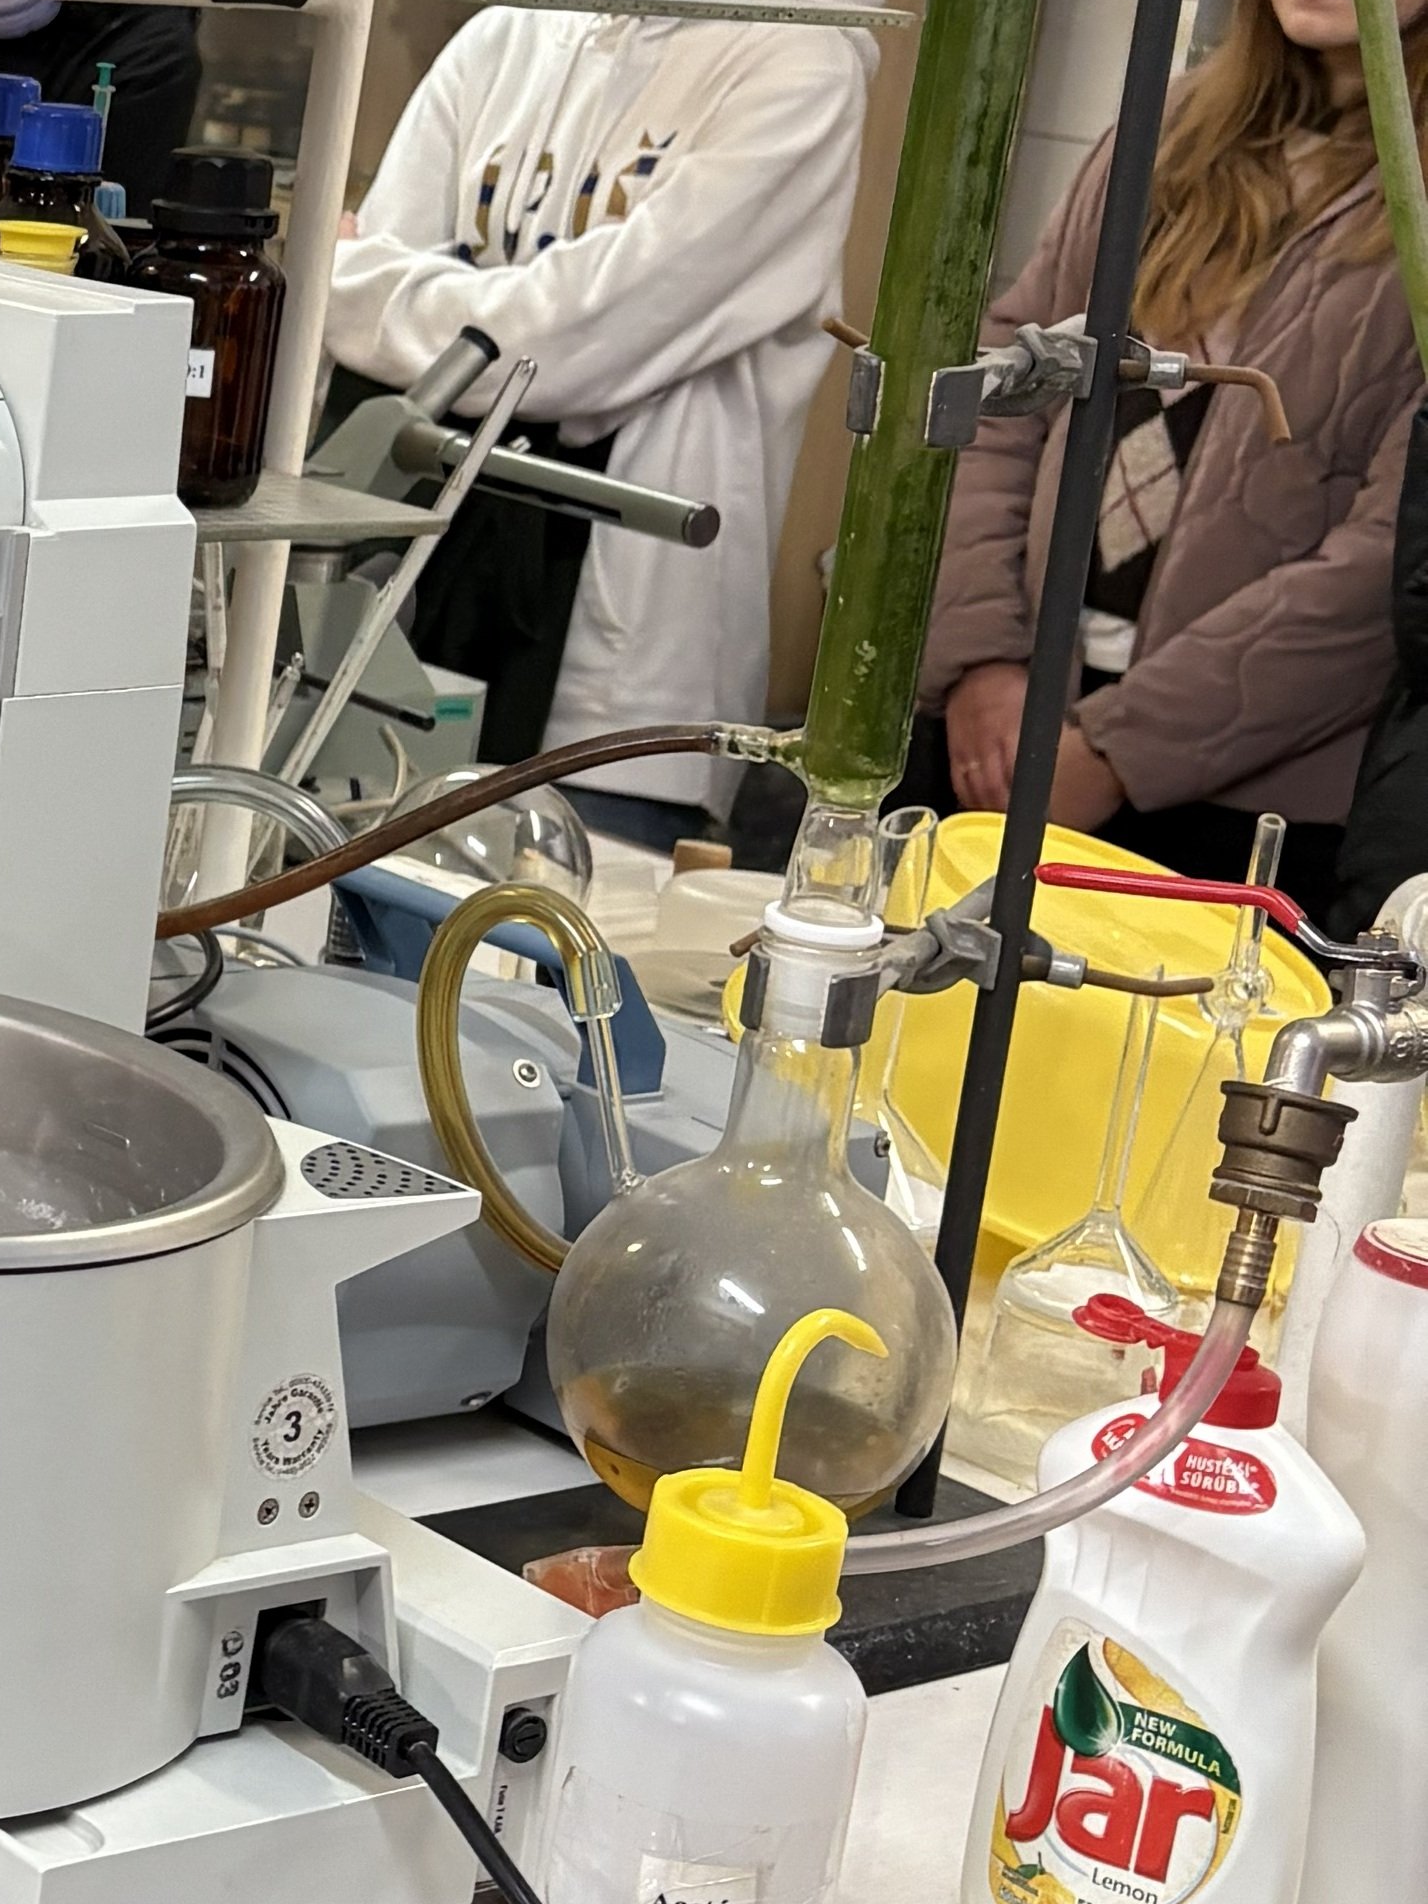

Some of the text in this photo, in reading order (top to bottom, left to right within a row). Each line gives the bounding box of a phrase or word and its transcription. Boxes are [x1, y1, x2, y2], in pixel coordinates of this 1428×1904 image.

[186, 364, 205, 379] :1
[283, 1410, 302, 1443] 3
[1133, 1712, 1178, 1738] NEW
[1131, 1727, 1222, 1777] FORMULA
[1004, 1704, 1217, 1884] Jar
